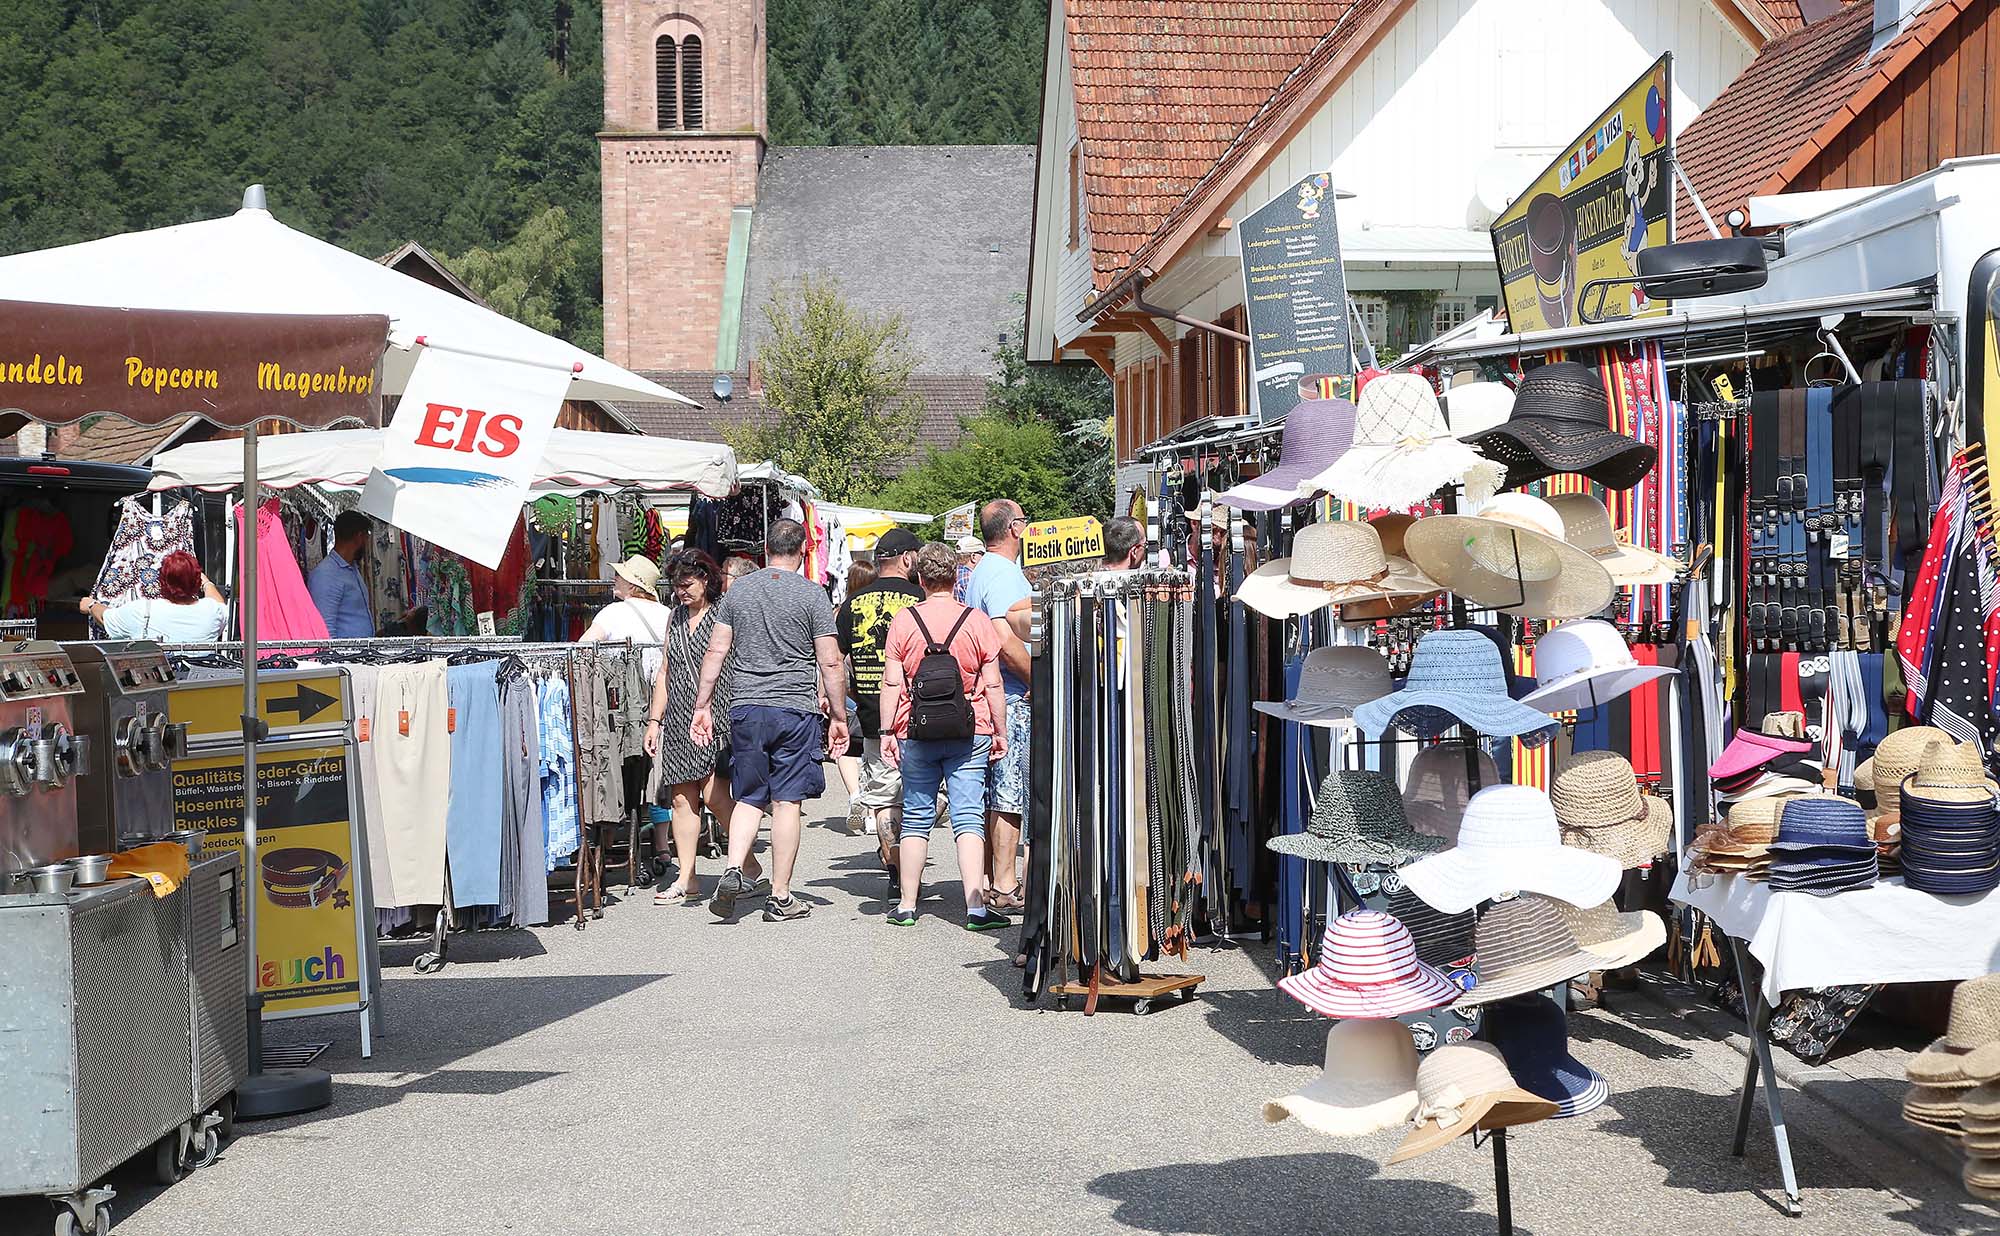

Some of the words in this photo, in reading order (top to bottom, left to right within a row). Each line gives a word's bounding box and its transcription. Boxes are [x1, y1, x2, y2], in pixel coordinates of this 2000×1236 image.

[1604, 113, 1622, 145] VISA
[1576, 184, 1625, 242] HOSENTRÄGER
[1498, 233, 1530, 275] GÜRTEL
[125, 356, 218, 395] Popcorn
[257, 362, 374, 399] Magenbrot
[414, 402, 524, 458] EIS
[1027, 539, 1062, 559] Elastik
[1065, 533, 1100, 556] Gürtel
[173, 759, 343, 787] Qualitäts-eder-Gürtel
[175, 786, 206, 796] Büffel-,
[267, 779, 294, 788] Bison-
[295, 777, 302, 785] &
[303, 774, 342, 784] Rindleder
[174, 794, 270, 814] Hosenträer
[175, 815, 238, 831] Buckles
[256, 946, 344, 988] auch
